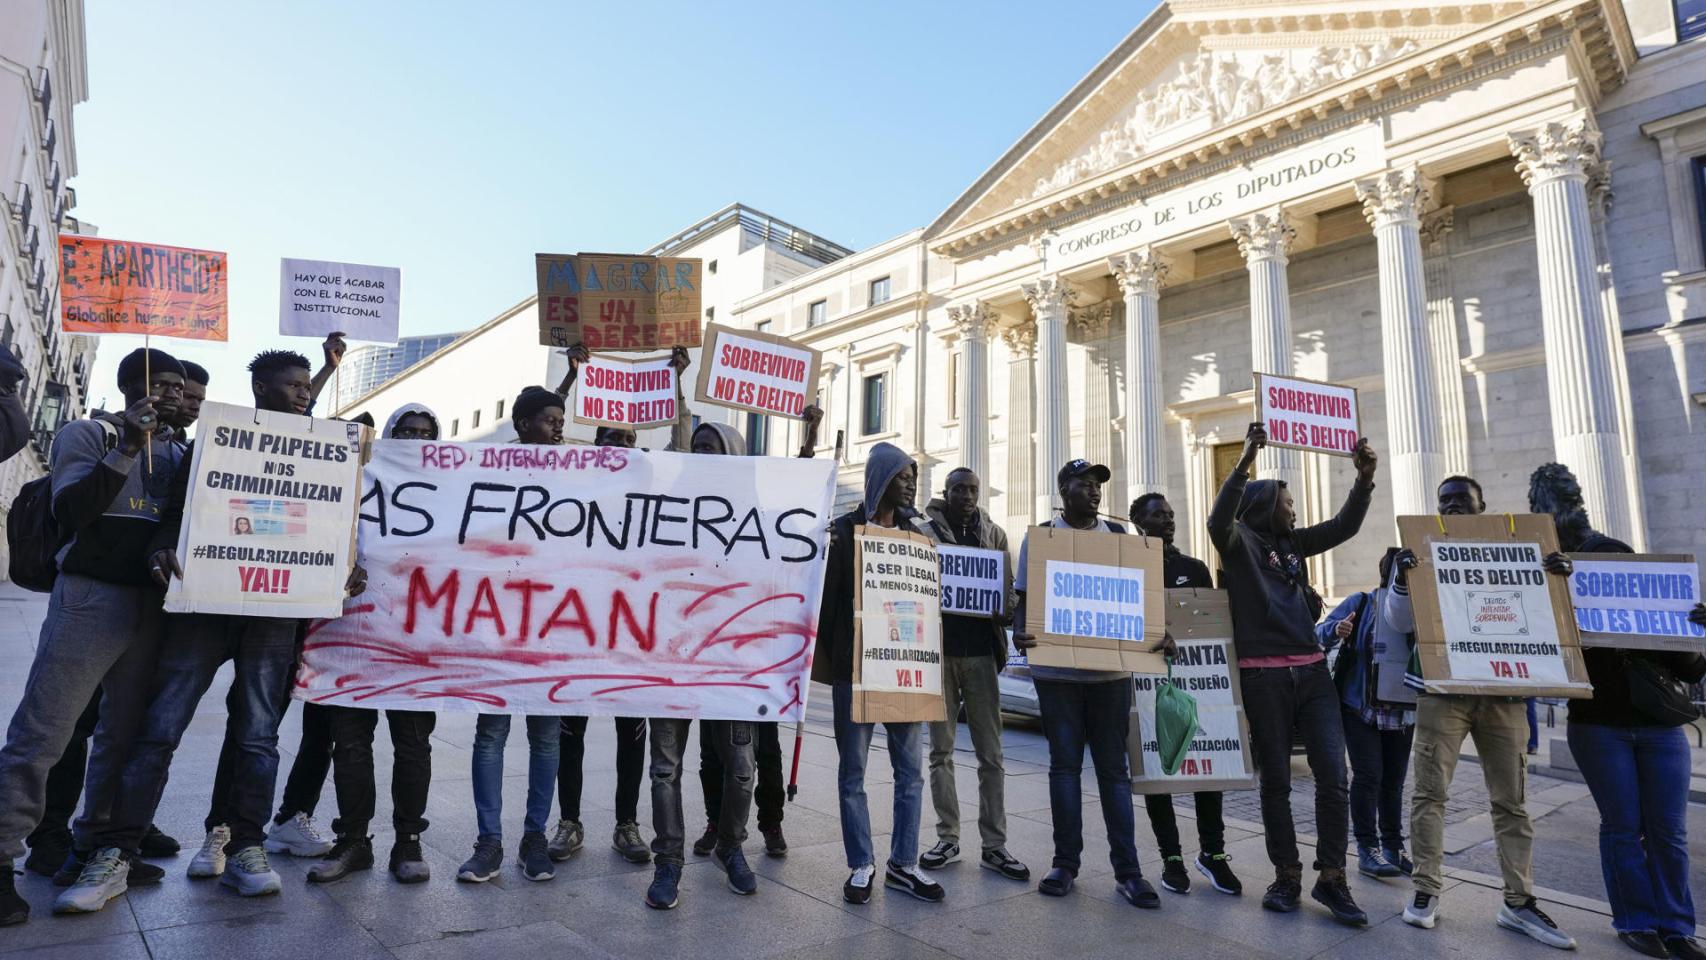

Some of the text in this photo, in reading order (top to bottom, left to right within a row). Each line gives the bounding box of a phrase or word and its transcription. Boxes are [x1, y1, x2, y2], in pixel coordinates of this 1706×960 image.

[1058, 146, 1356, 257] CONGRESO DE LOS DIPUTADOS
[294, 273, 385, 290] HAY QUE ACABAR
[294, 288, 385, 304] CON EL RACISMO
[66, 305, 129, 324] Globalice
[135, 308, 176, 326] human
[293, 303, 382, 318] INSTITUCIONAL
[546, 296, 636, 325] ES UN
[721, 343, 806, 383] SOBREVIVIR
[585, 365, 671, 393] SOBREVIVIR
[713, 375, 805, 416] NO ES DELITO
[1269, 386, 1351, 419] SOBREVIVIR
[583, 396, 675, 423] NO ES DELITO
[214, 425, 349, 463] SIN PAPELES
[1269, 418, 1357, 452] NO ES DELITO
[263, 460, 295, 477] NOS
[421, 444, 467, 469] RED
[206, 470, 343, 503] CRIMINALIZAN
[359, 478, 819, 563] AS FRONTERAS
[192, 544, 335, 567] #REGULARIZACIÓN
[863, 540, 937, 564] ME OBLIGAN
[1437, 546, 1537, 563] SOBREVIVIR
[238, 565, 292, 594] YA!!
[865, 562, 938, 583] A SER ILEGAL
[1438, 568, 1545, 586] NO ES DELITO
[864, 579, 938, 598] AL MENOS 3 AÑOS
[1053, 571, 1140, 605] SOBREVIVIR
[1575, 571, 1694, 600] SOBREVIVIR
[403, 566, 660, 653] MATAN
[955, 586, 1001, 612] DELITO
[1052, 607, 1144, 641] NO ES DELITO
[1576, 607, 1604, 631] NO
[1606, 608, 1632, 633] ES
[864, 647, 940, 664] #REGULARIZACIÓN
[1449, 641, 1559, 656] #REGULARIZACIÓN
[895, 668, 923, 688] YA !!
[1489, 660, 1530, 679] YA !!
[1135, 677, 1152, 691] NO
[1171, 677, 1187, 691] MI
[1190, 674, 1230, 691] SUEÑO
[1201, 759, 1213, 775] !!
